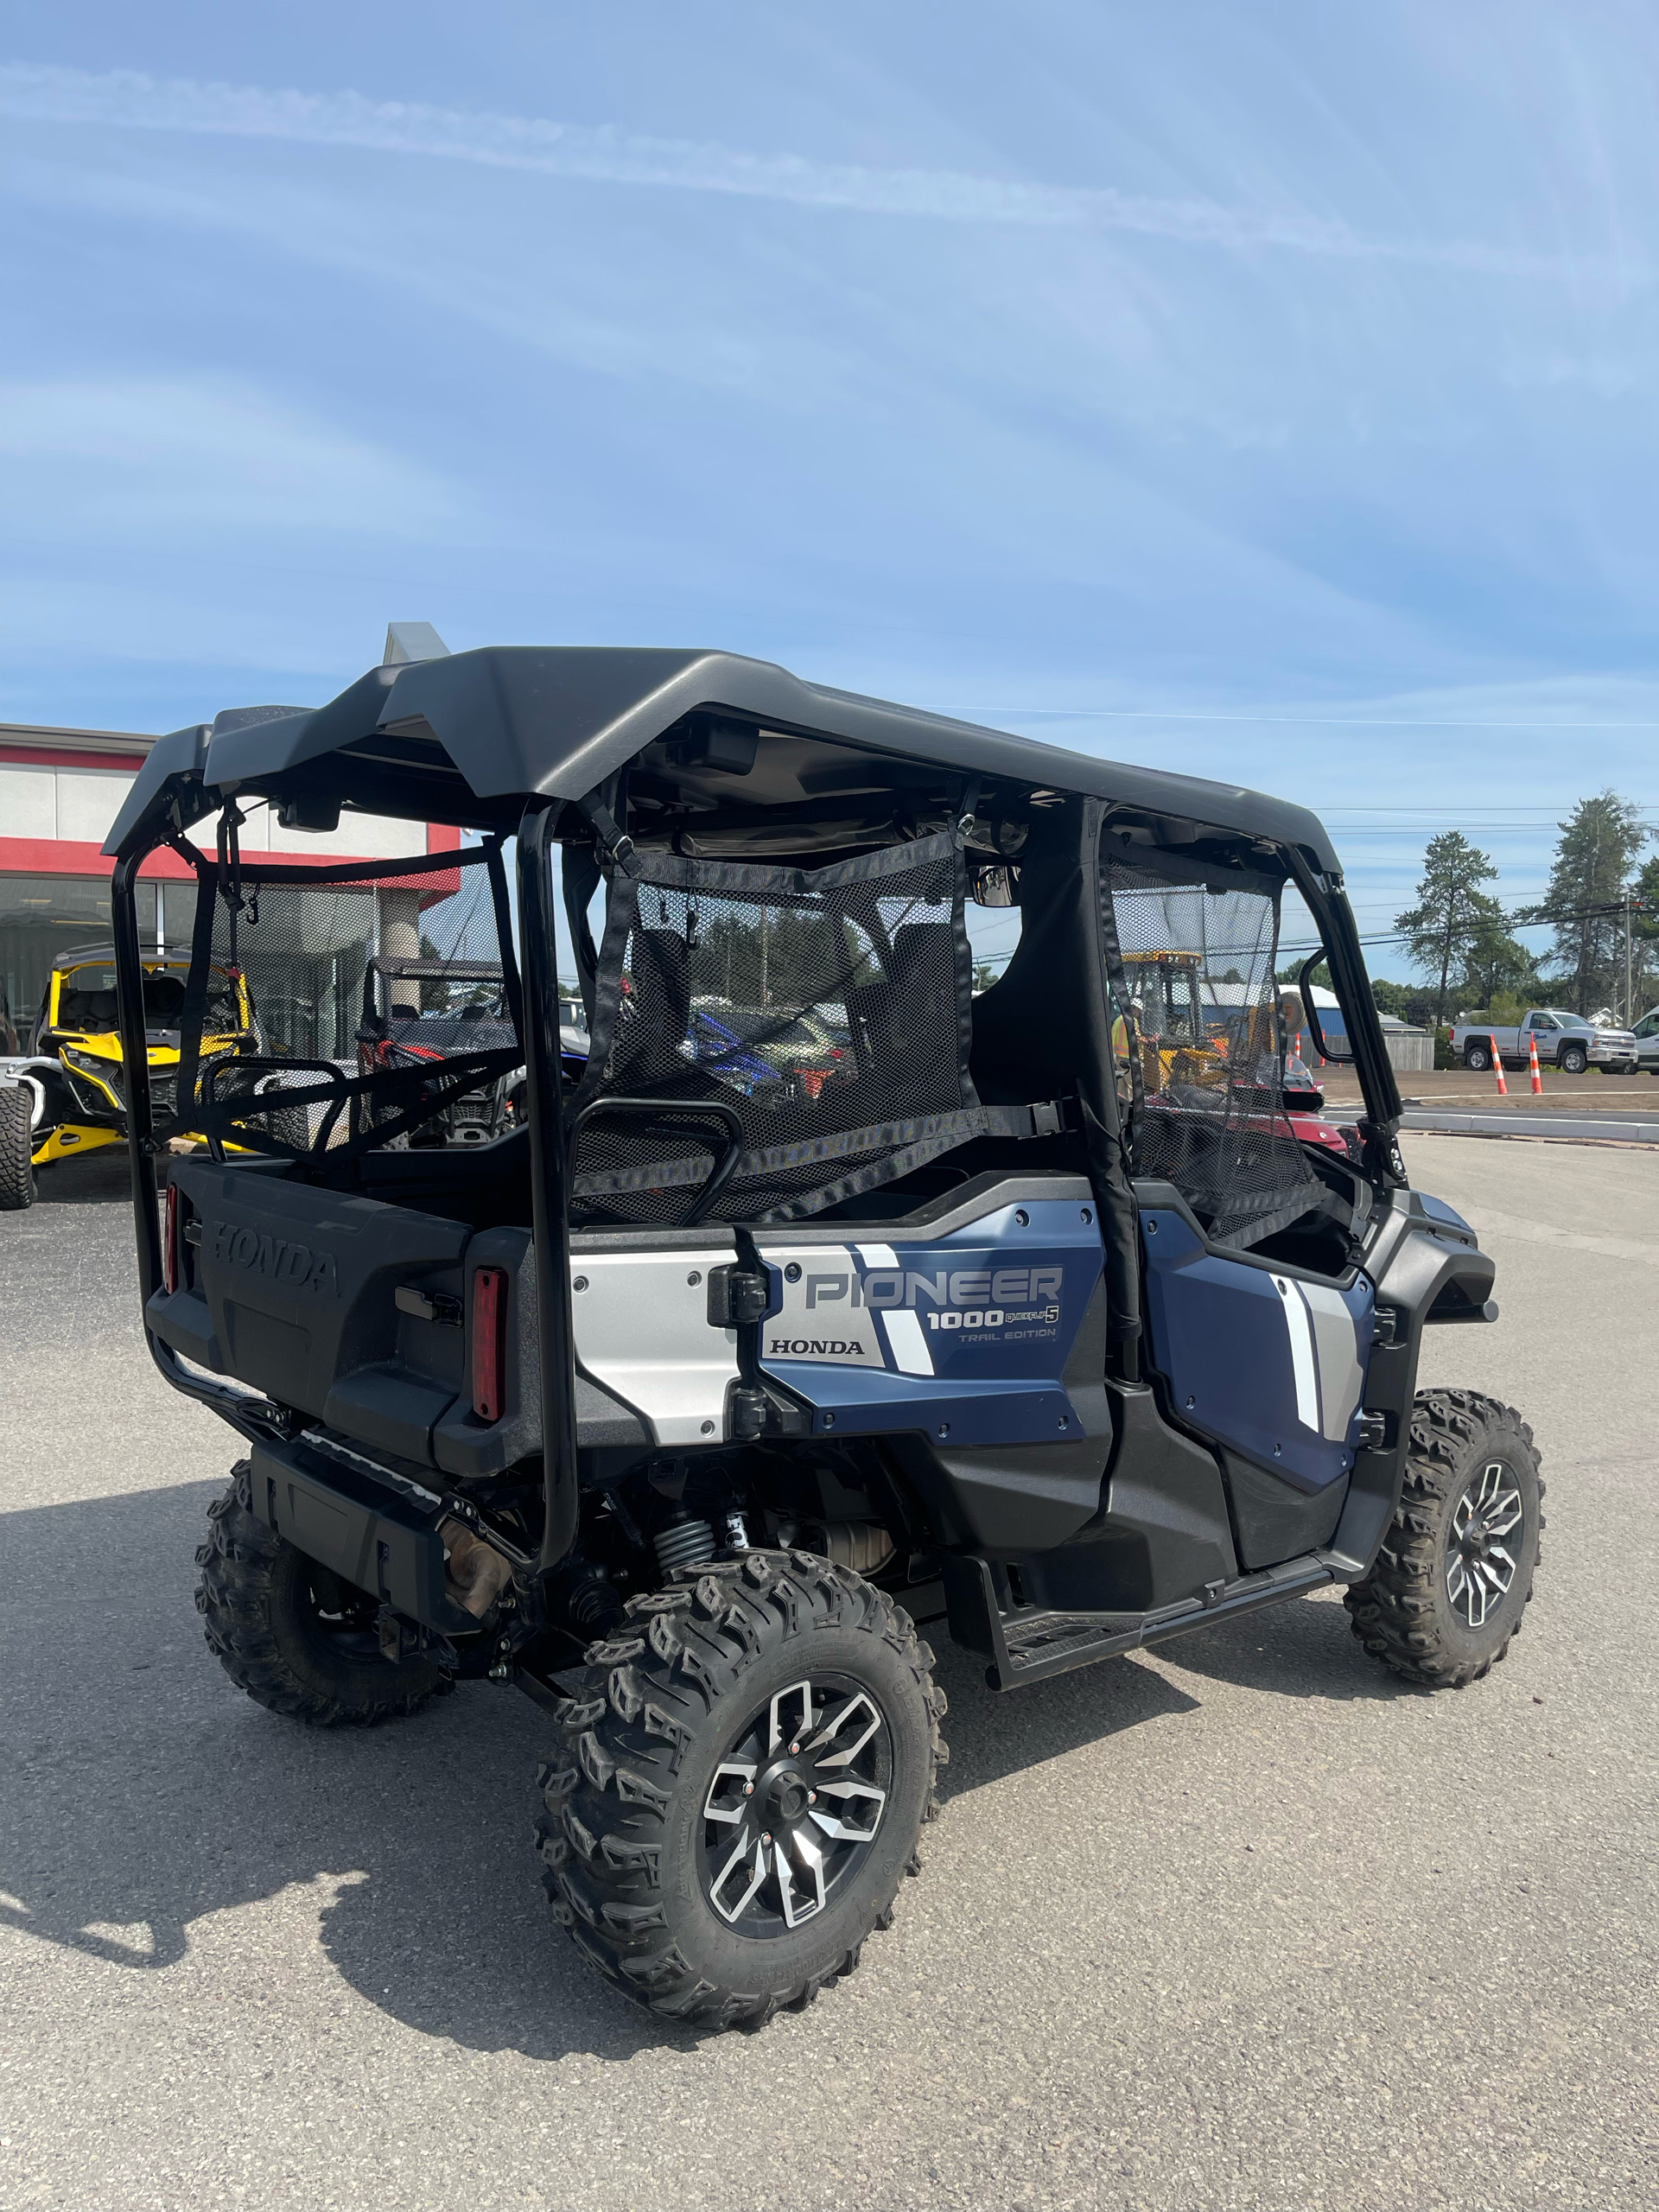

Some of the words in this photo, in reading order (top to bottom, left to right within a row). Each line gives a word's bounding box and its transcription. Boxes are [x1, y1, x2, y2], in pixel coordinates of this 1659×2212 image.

[213, 1220, 340, 1298] HONDA
[805, 1268, 1064, 1309] PIONEER
[927, 1310, 1004, 1330] 1000
[958, 1332, 1001, 1343] TRAIL
[1004, 1329, 1056, 1340] EDITION
[770, 1339, 865, 1355] HONDA
